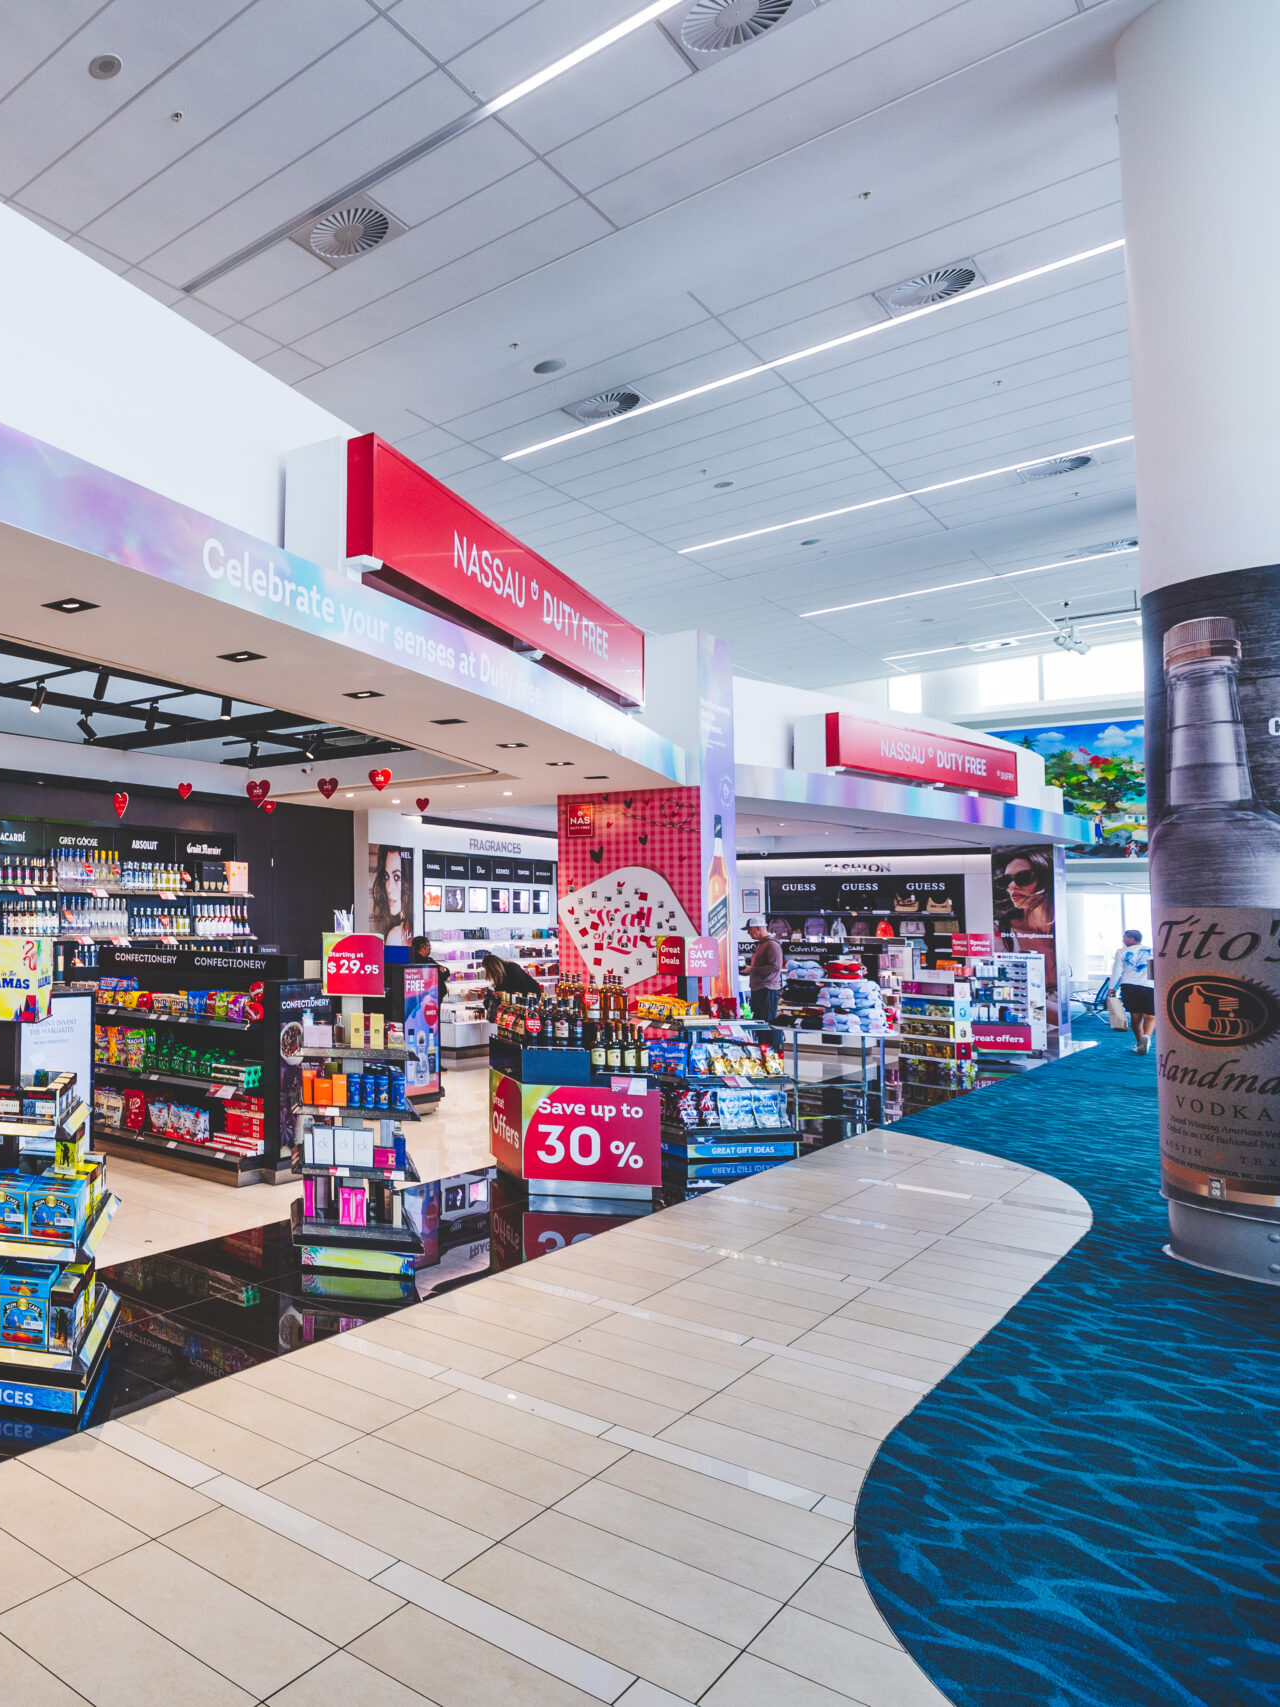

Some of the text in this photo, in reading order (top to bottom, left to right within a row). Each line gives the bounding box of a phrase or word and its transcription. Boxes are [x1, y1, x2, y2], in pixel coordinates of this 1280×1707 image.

[453, 529, 609, 661] NASSAU DUTY FREE
[202, 537, 336, 624] Celebrate
[339, 601, 390, 645] your
[393, 624, 456, 669] senses
[458, 651, 477, 679] at
[480, 653, 517, 697] Duty
[881, 739, 987, 777] NASSAU DUTY FREE
[1001, 771, 1014, 782] DUFRY
[570, 816, 591, 826] NAS
[59, 836, 99, 847] GREY GOOSE
[131, 839, 159, 850] ABSOLUT
[469, 838, 522, 854] FRAGRANCES
[476, 864, 485, 874] Dior
[824, 863, 891, 873] FASHION
[782, 883, 817, 891] GUESS
[841, 883, 879, 891] GUESS
[906, 882, 946, 891] GUESS
[660, 945, 681, 955] Great
[789, 945, 828, 953] Calvin Klein
[114, 952, 177, 965] CONFECTIONERY
[328, 951, 364, 960] Starting at
[690, 950, 714, 960] SAVE
[194, 956, 267, 970] CONFECTIONERY
[660, 956, 680, 966] Deals
[690, 959, 708, 968] 30%
[327, 959, 380, 975] $ 29.95
[8, 969, 17, 977] the
[405, 980, 425, 993] FREE
[281, 998, 330, 1010] CONFECTIONERY
[42, 1026, 74, 1034] MARGARITA
[996, 1034, 1024, 1043] offers
[492, 1093, 505, 1110] Great
[538, 1098, 643, 1122] Save up to
[1176, 1095, 1274, 1122] VODKA
[492, 1112, 519, 1149] Offers
[1188, 1119, 1220, 1133] Winning
[1221, 1125, 1262, 1137] American
[1200, 1132, 1214, 1142] Old
[537, 1124, 643, 1169] 30 %
[712, 1147, 735, 1155] GREAT
[753, 1146, 775, 1154] IDEAS
[1166, 1139, 1202, 1158] AUSTIN
[6, 1196, 19, 1205] CAKE
[57, 1200, 69, 1210] CAKE
[6, 1300, 41, 1314] RUM CAKE
